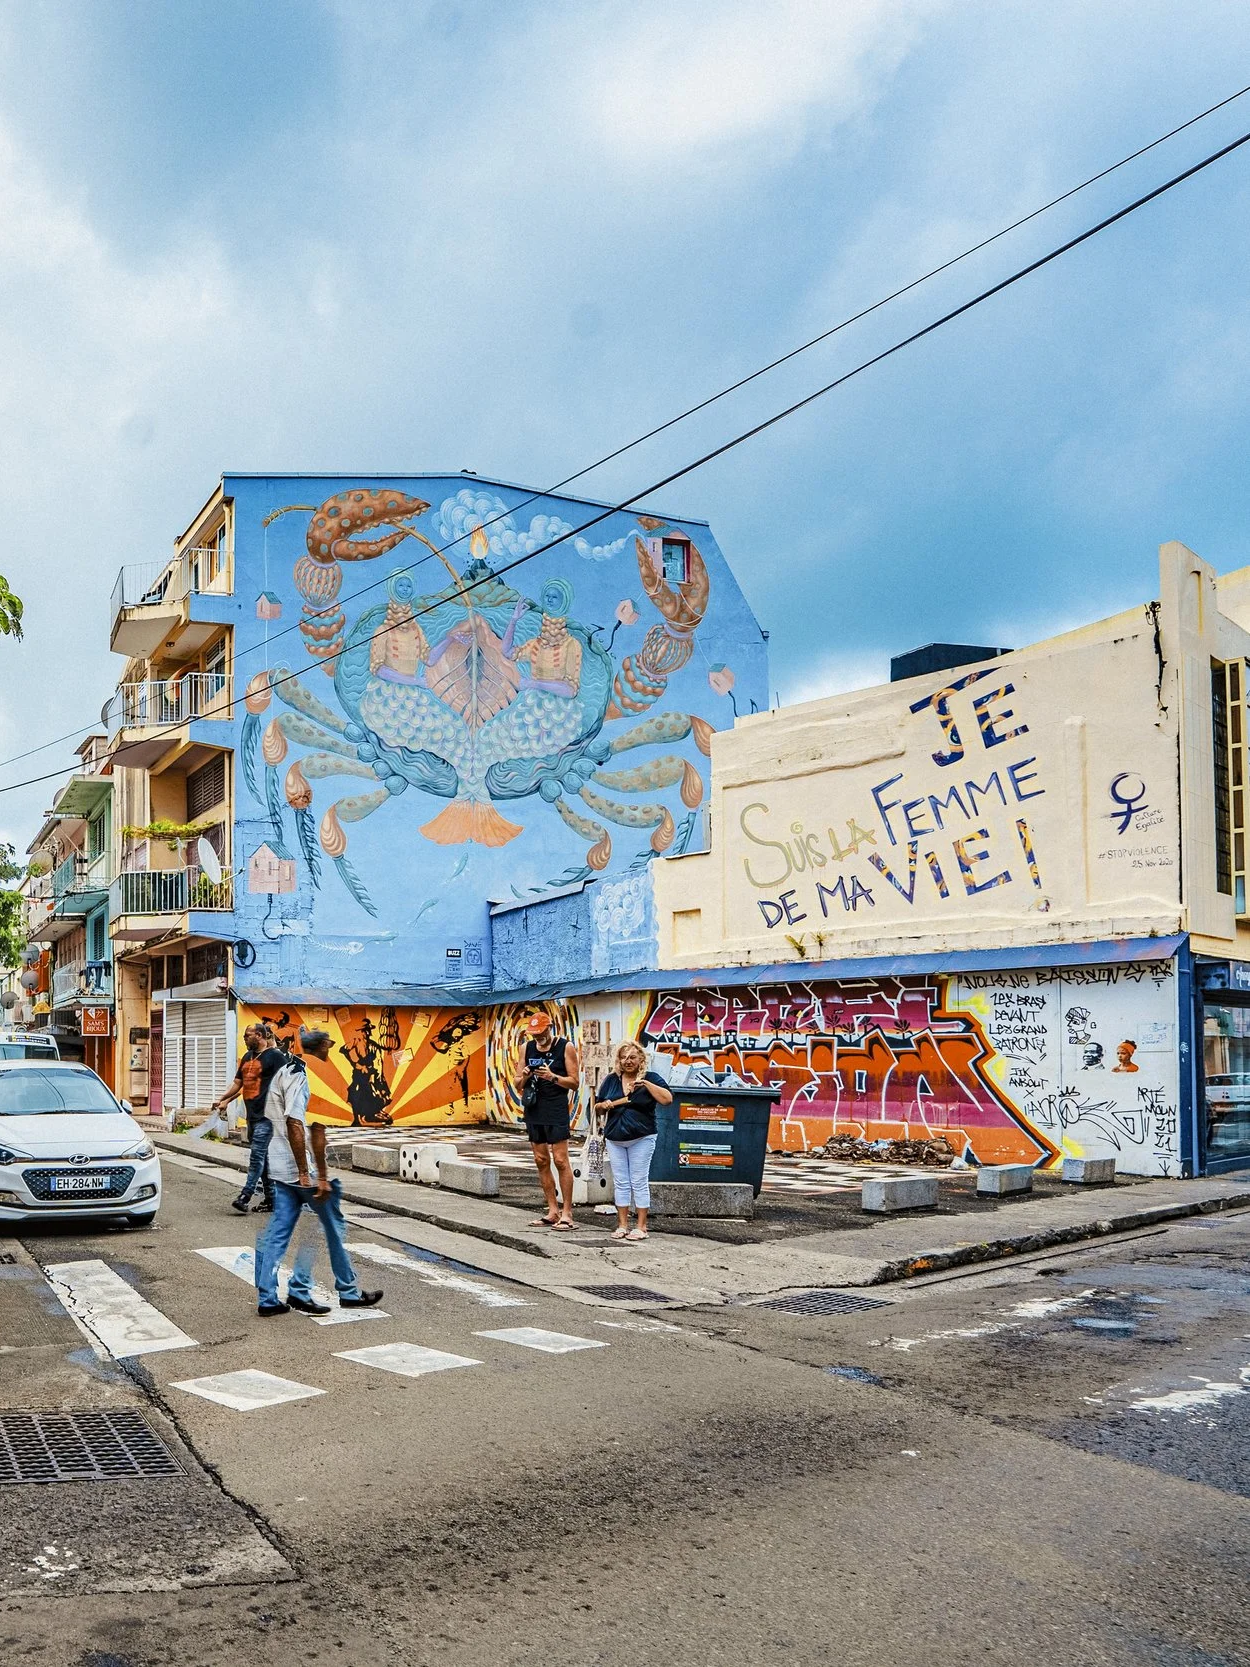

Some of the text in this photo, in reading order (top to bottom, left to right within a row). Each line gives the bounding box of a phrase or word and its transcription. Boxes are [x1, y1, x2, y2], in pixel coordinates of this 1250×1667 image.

[908, 664, 1030, 767] JE
[828, 817, 878, 862] LA
[871, 756, 1046, 846] FEMME
[758, 889, 808, 929] DE
[815, 875, 876, 918] MA
